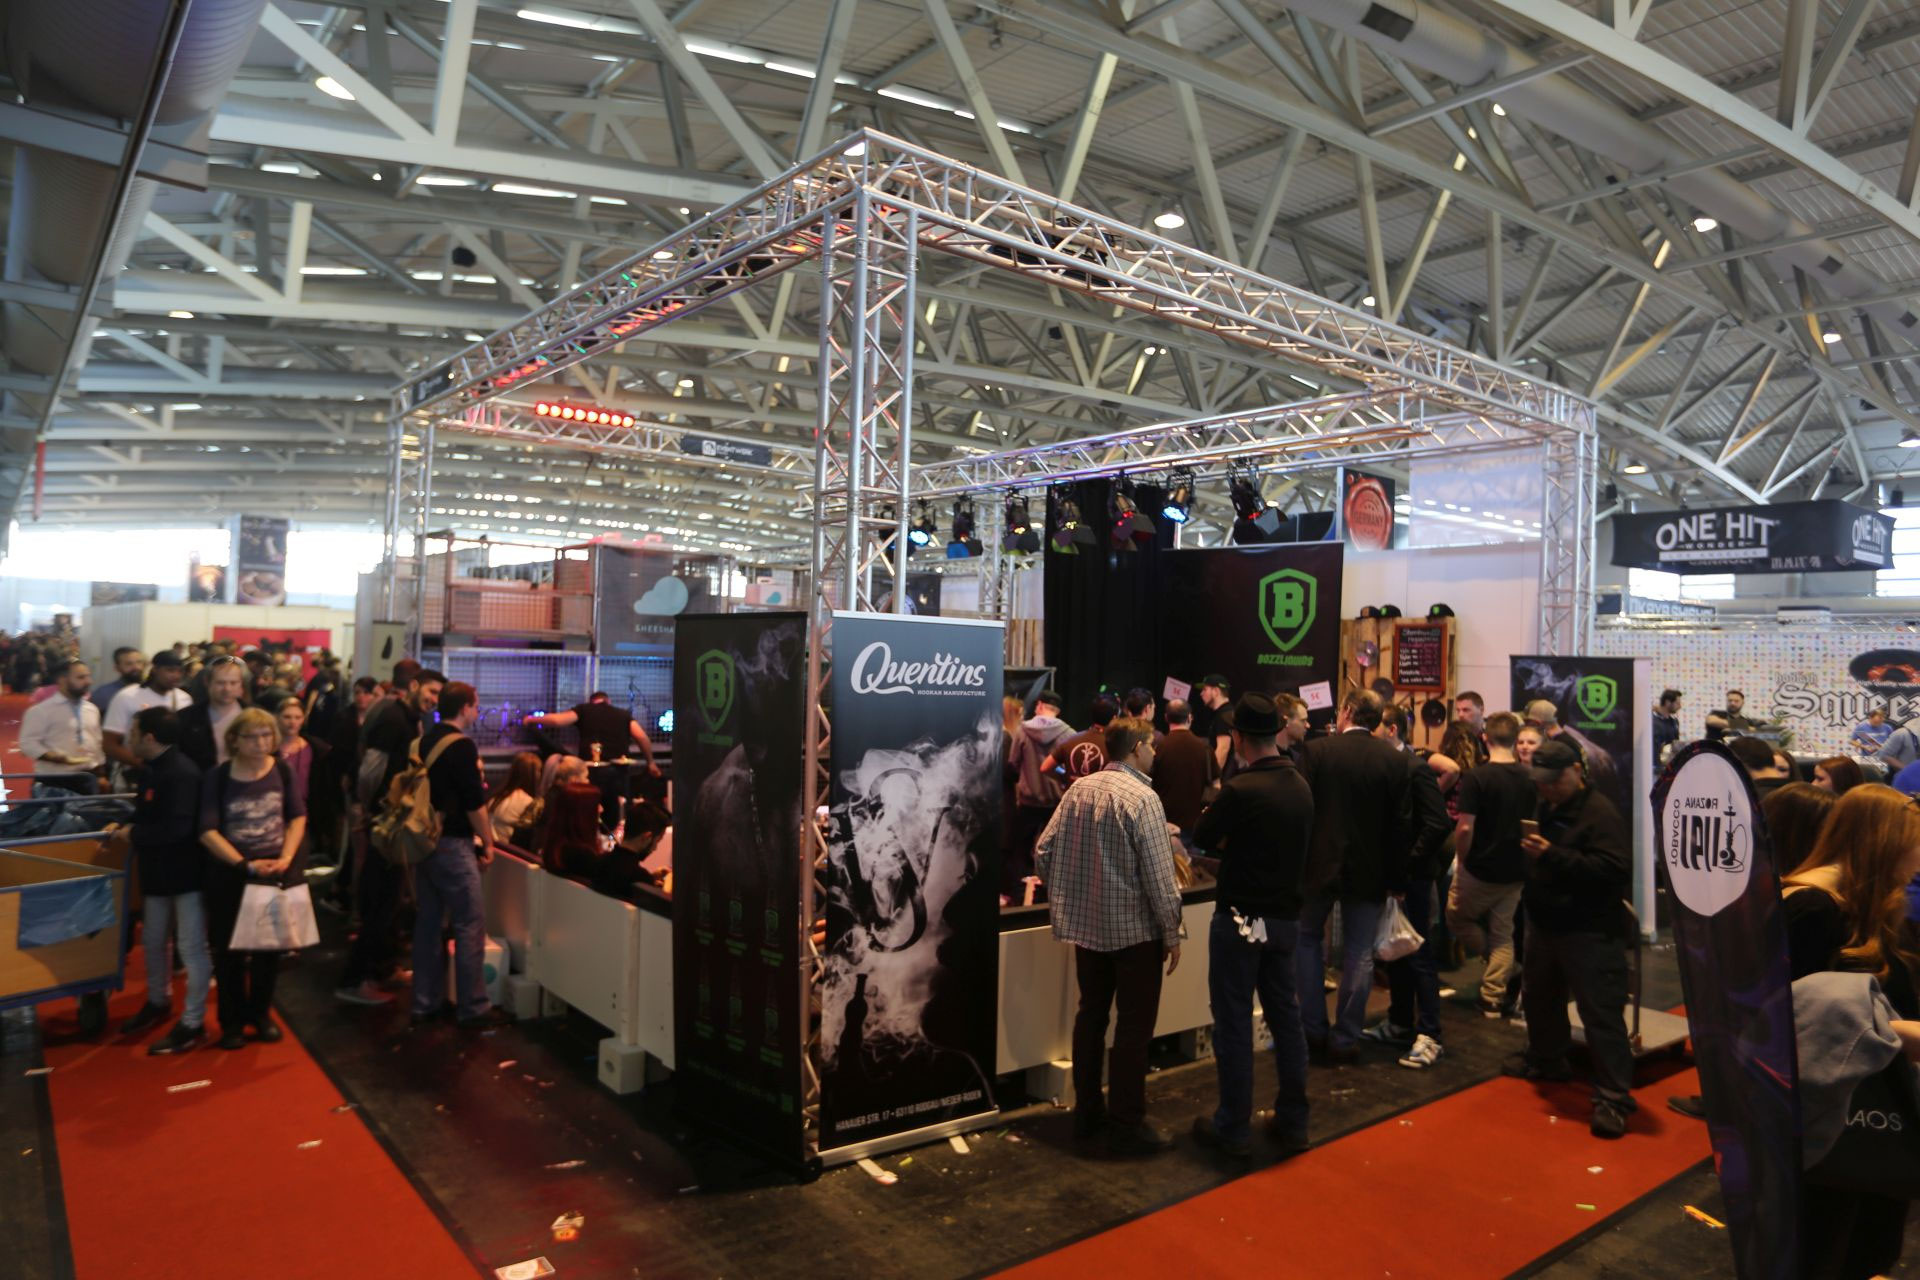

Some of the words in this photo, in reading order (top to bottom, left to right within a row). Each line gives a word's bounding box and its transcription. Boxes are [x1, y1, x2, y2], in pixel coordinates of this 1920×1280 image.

[1656, 512, 1717, 551] ONE
[1725, 512, 1775, 546] HIT
[1685, 541, 1745, 550] WONDER
[851, 641, 987, 694] Quentins
